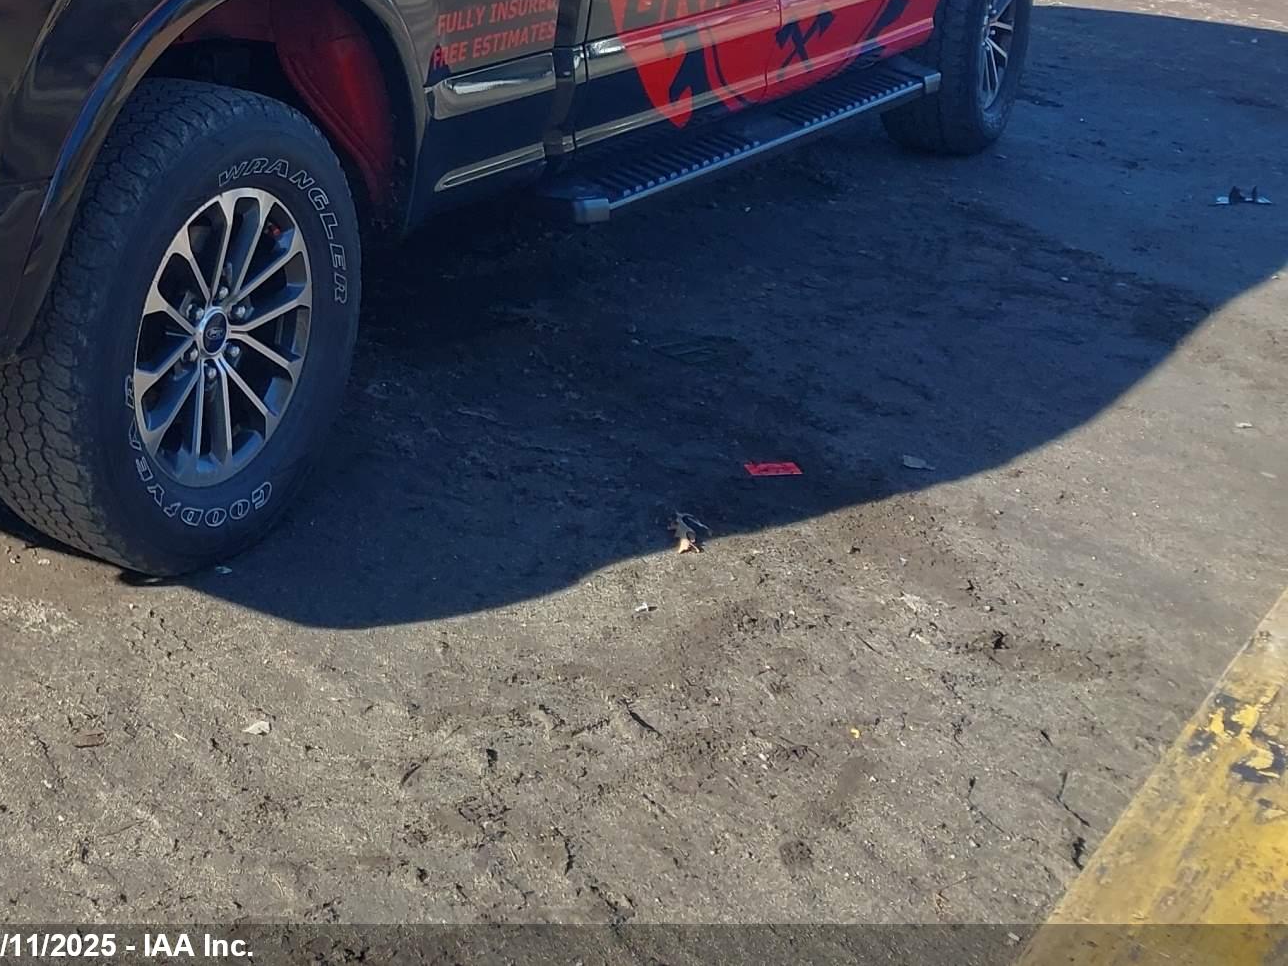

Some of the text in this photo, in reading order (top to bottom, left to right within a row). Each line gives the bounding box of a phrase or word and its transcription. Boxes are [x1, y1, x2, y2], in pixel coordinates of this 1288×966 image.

[433, 20, 557, 70] FREE ESTIMATES
[438, 5, 486, 36] FULLY
[218, 158, 347, 304] WRANGLER
